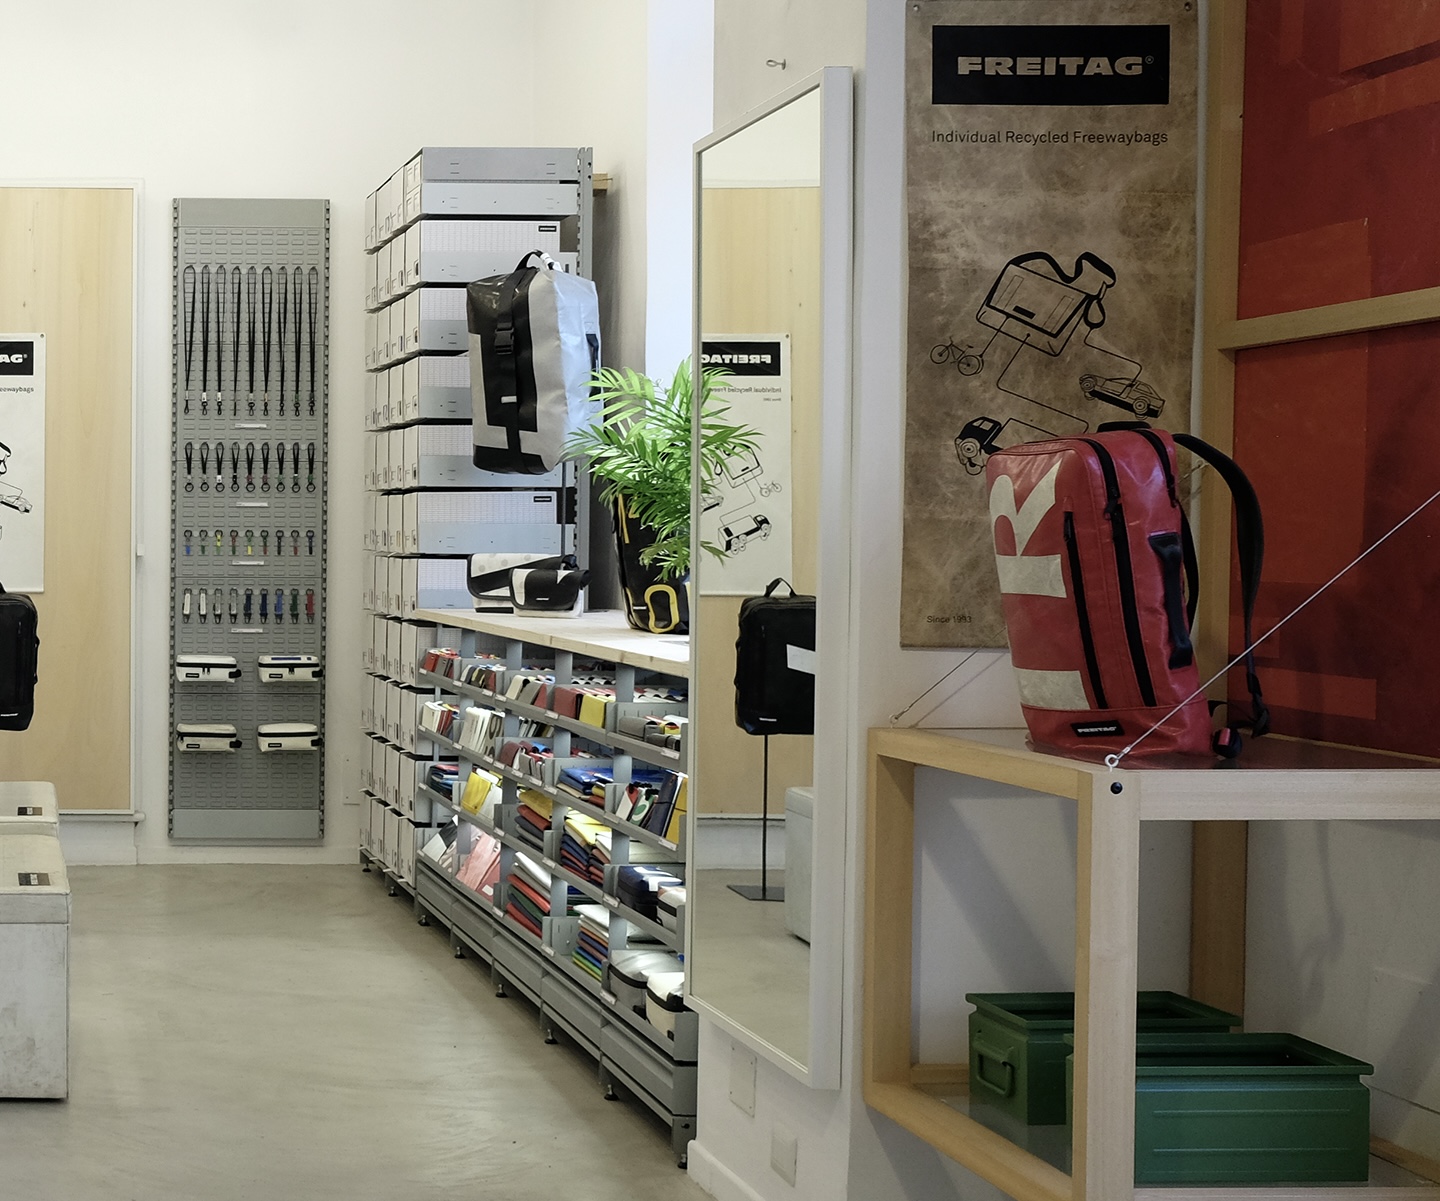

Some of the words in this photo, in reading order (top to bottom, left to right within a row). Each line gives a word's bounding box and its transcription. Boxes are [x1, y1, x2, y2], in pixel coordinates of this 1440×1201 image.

[931, 130, 1002, 143] Individual
[1005, 130, 1069, 146] Recycled
[1073, 130, 1169, 147] Freewaybags
